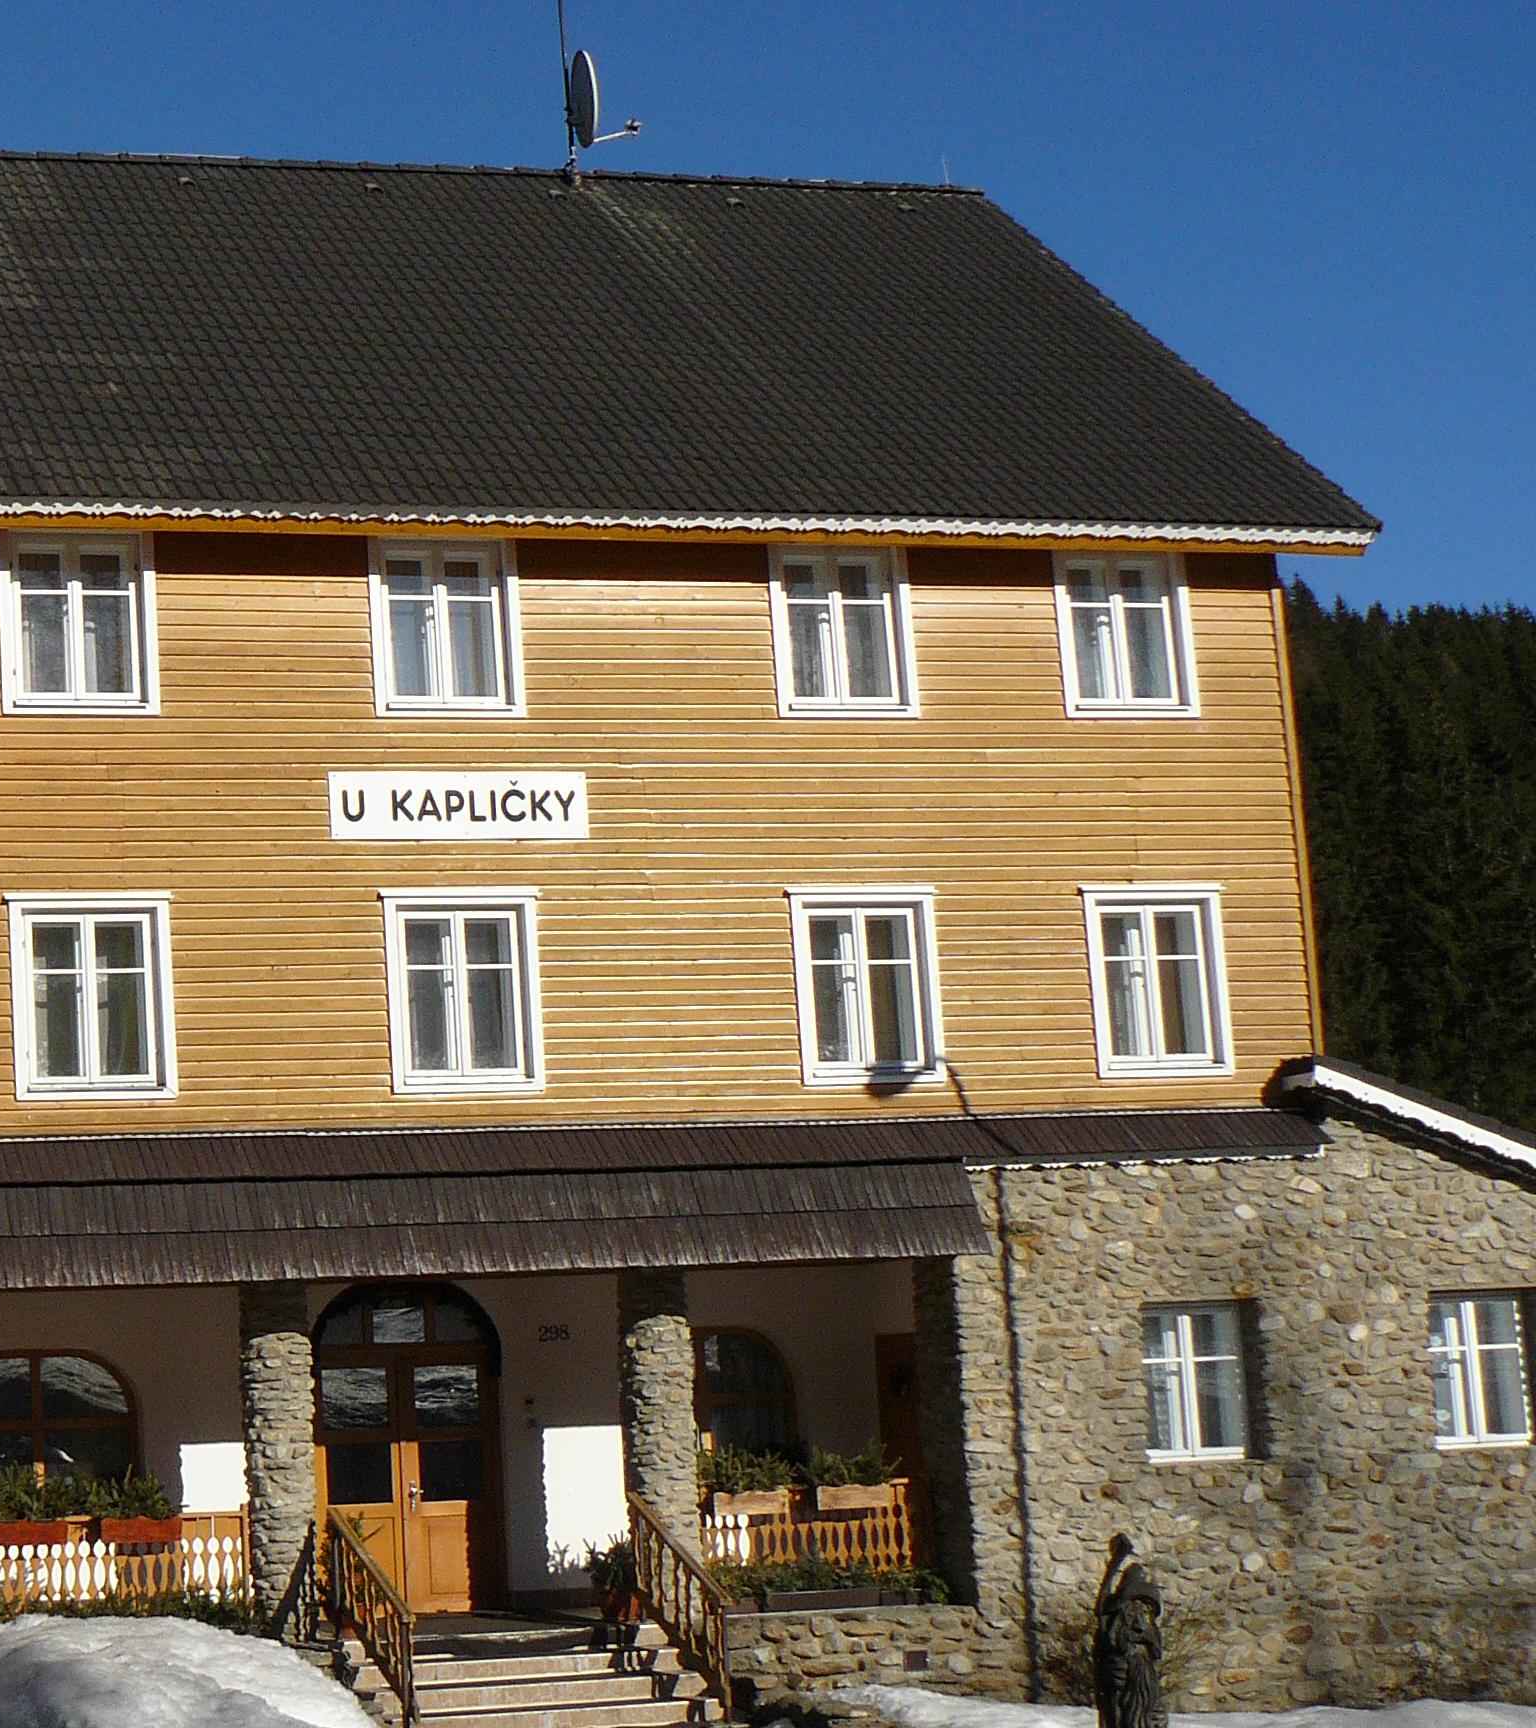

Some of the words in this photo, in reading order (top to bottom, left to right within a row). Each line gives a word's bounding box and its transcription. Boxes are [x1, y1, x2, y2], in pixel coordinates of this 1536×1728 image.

[341, 788, 365, 822] U
[390, 780, 576, 822] KAPLIČKY
[538, 1323, 570, 1342] 298
